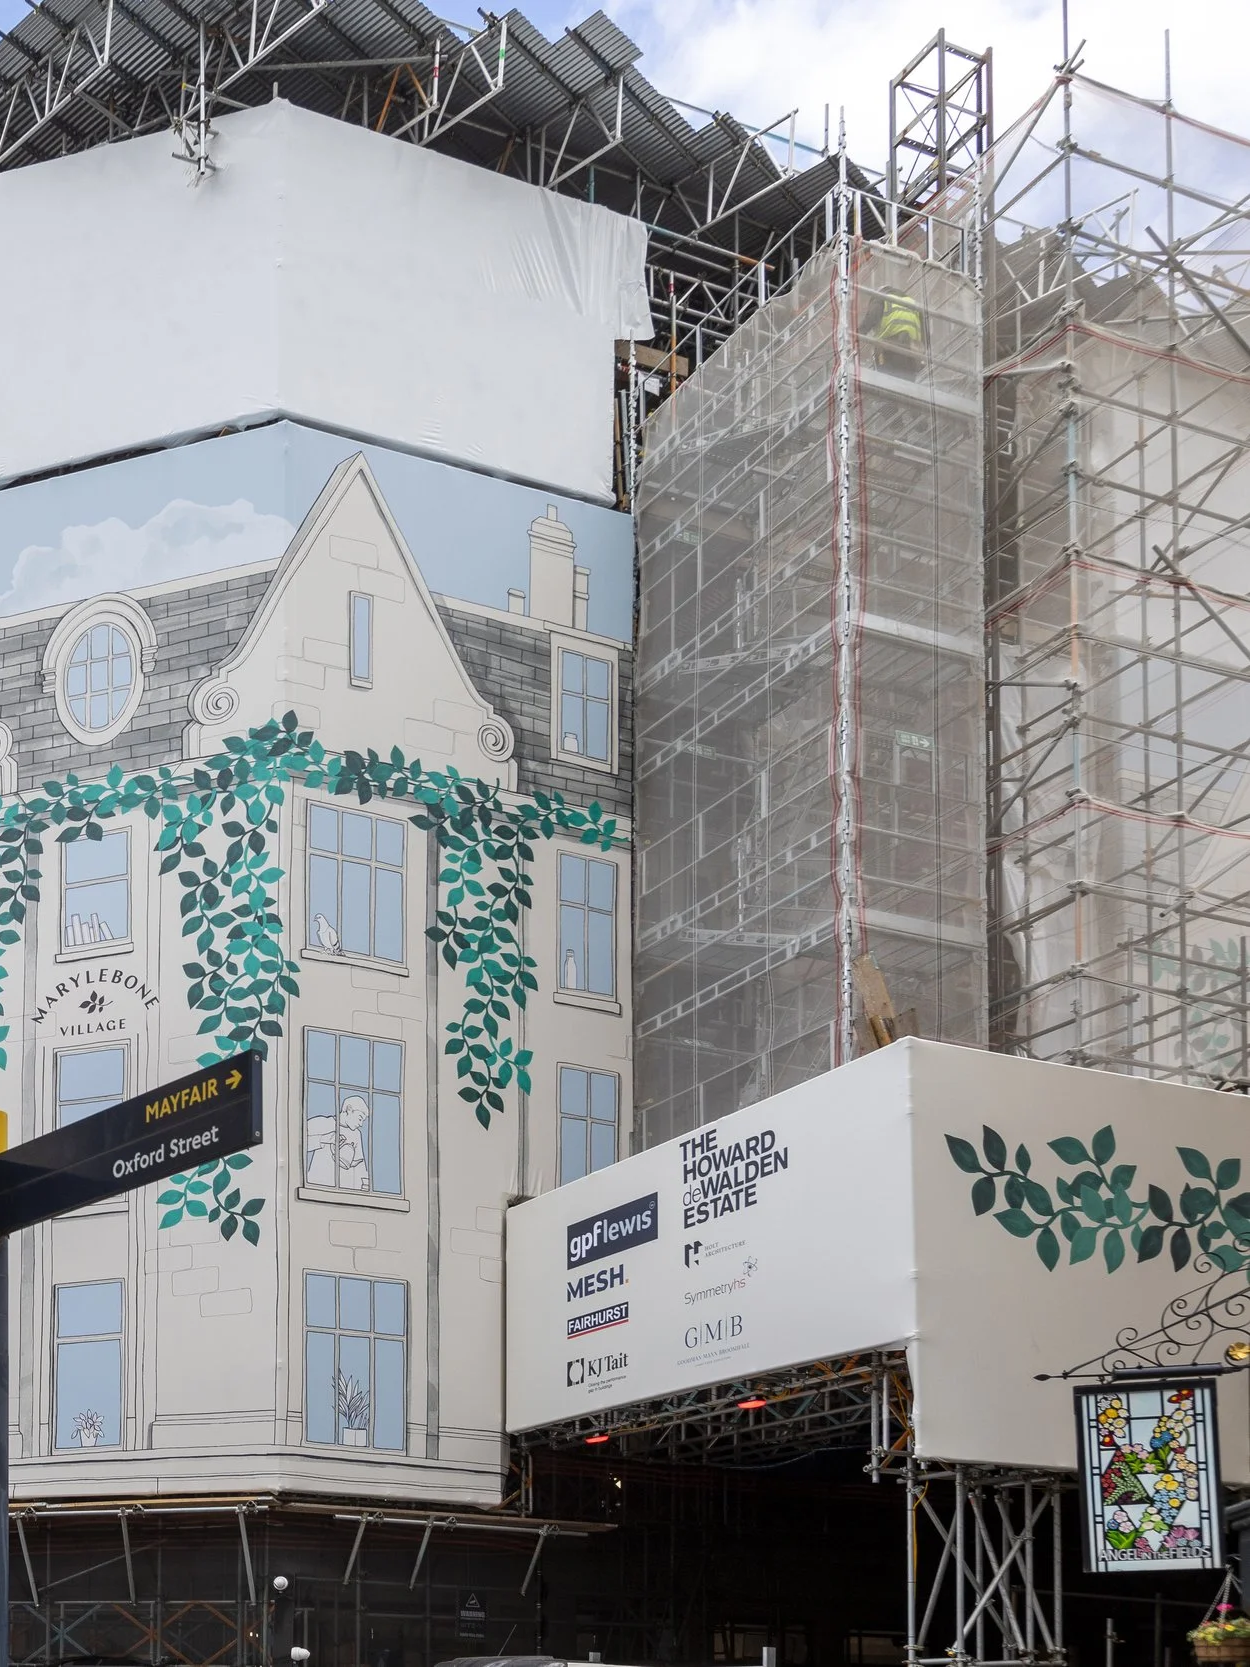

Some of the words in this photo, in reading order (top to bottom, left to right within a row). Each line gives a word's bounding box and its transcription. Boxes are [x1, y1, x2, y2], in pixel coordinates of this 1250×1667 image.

[30, 968, 160, 1025] MARYLEBONE
[60, 1018, 126, 1036] VILLAGE
[145, 1078, 218, 1123] MAYFAIR
[112, 1143, 165, 1178] Oxford
[169, 1125, 219, 1158] Street
[679, 1128, 718, 1162] THE
[683, 1130, 776, 1184] HOWARD
[684, 1183, 757, 1229] ESTATE
[568, 1304, 628, 1334] FAIRHURST
[604, 1352, 629, 1372] Tait
[1100, 1549, 1141, 1561] ANGEL
[1170, 1546, 1211, 1559] FIELDS
